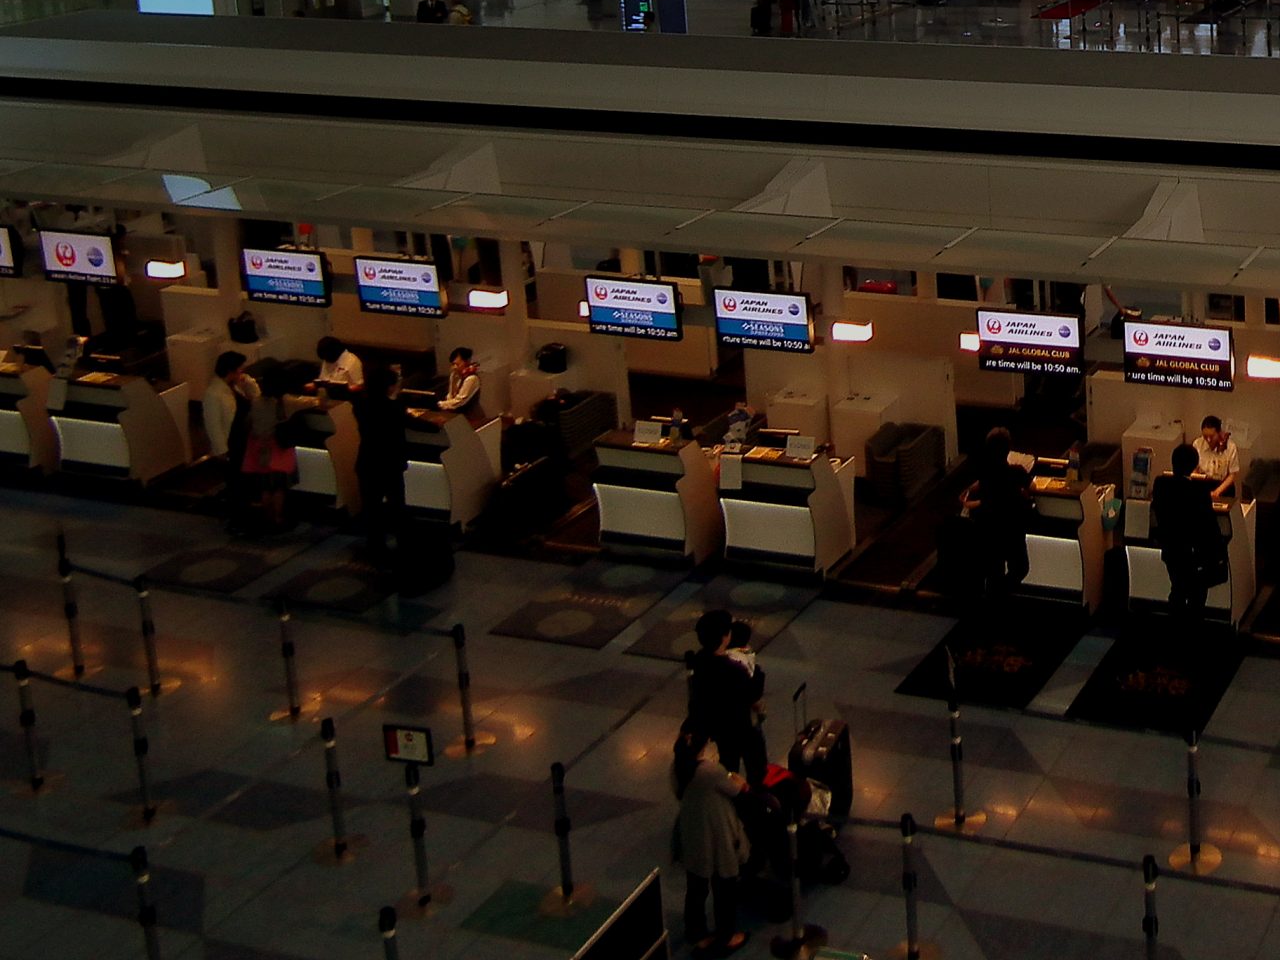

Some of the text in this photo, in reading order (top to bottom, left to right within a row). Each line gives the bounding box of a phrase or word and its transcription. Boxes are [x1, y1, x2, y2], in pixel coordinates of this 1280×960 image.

[613, 295, 652, 303] AIRLINES
[742, 306, 783, 315] AIRLINES
[1006, 321, 1036, 329] JAPAN
[1008, 328, 1053, 337] AIRLINES
[1153, 333, 1186, 341] JAPAN
[741, 337, 757, 345] time
[759, 338, 771, 346] will
[772, 339, 781, 347] be
[783, 340, 803, 349] 10:50
[1155, 341, 1202, 350] AIRLINES
[1021, 348, 1050, 357] GLOBAL
[1051, 350, 1070, 358] CLUB
[998, 359, 1016, 368] time
[1016, 361, 1030, 370] will
[1031, 362, 1042, 371] be
[1043, 363, 1065, 373] 10:50
[1155, 360, 1220, 372] JAL GLOBAL CLUB
[1147, 372, 1166, 382] time
[1166, 374, 1181, 384] will
[1182, 375, 1193, 385] be
[1195, 377, 1217, 387] 10:50
[1218, 380, 1232, 388] am
